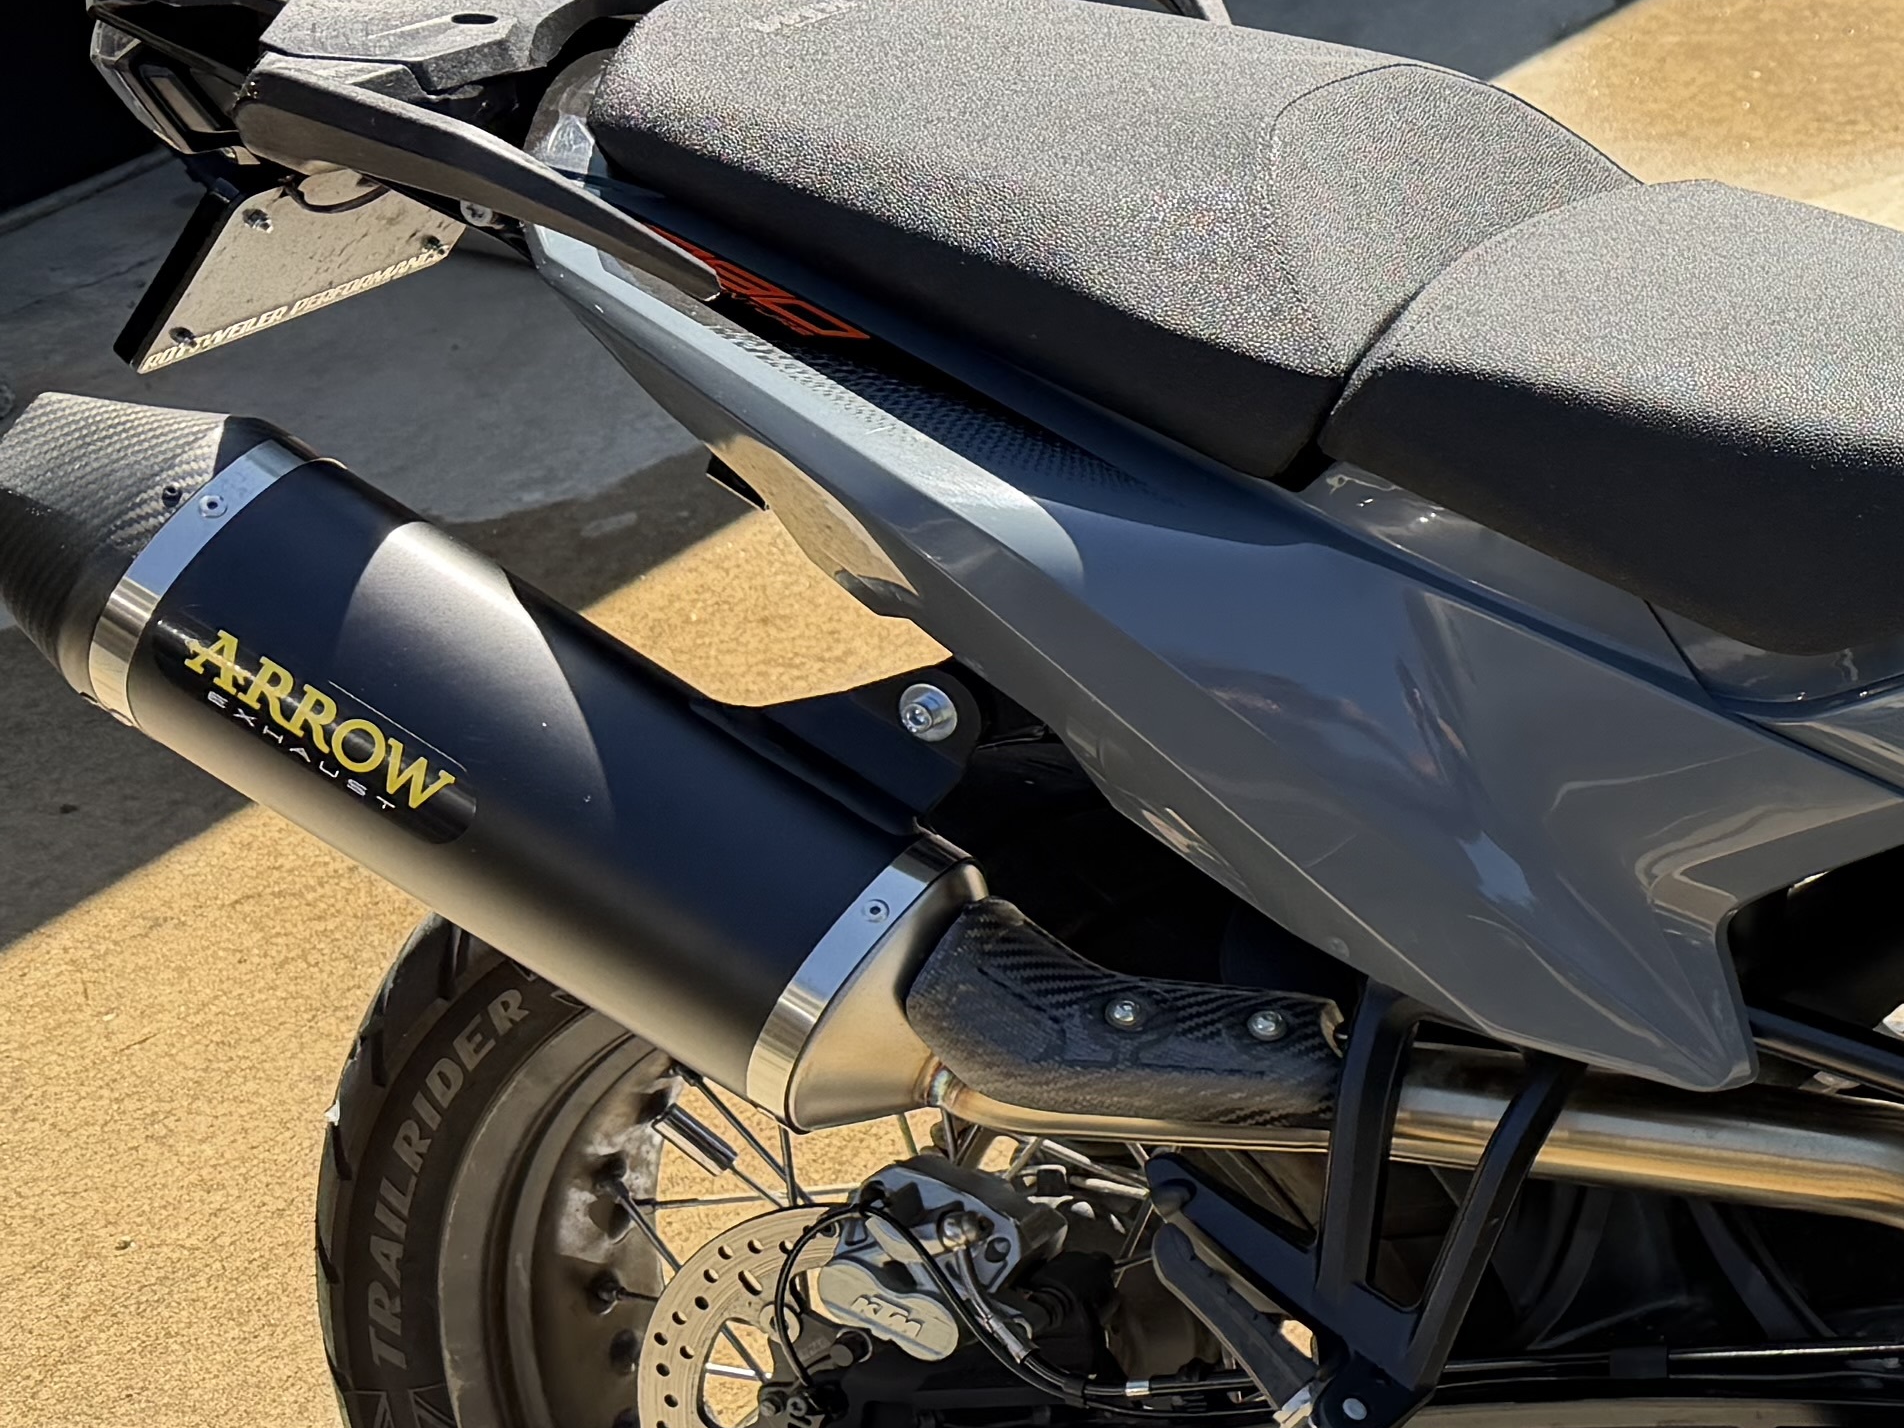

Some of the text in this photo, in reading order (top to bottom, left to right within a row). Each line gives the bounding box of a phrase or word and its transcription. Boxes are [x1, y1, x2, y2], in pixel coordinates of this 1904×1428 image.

[184, 629, 456, 809] ARROW
[207, 690, 396, 809] EXHAUST
[368, 988, 531, 1372] TRAILRIDER
[851, 1293, 925, 1339] KTM
